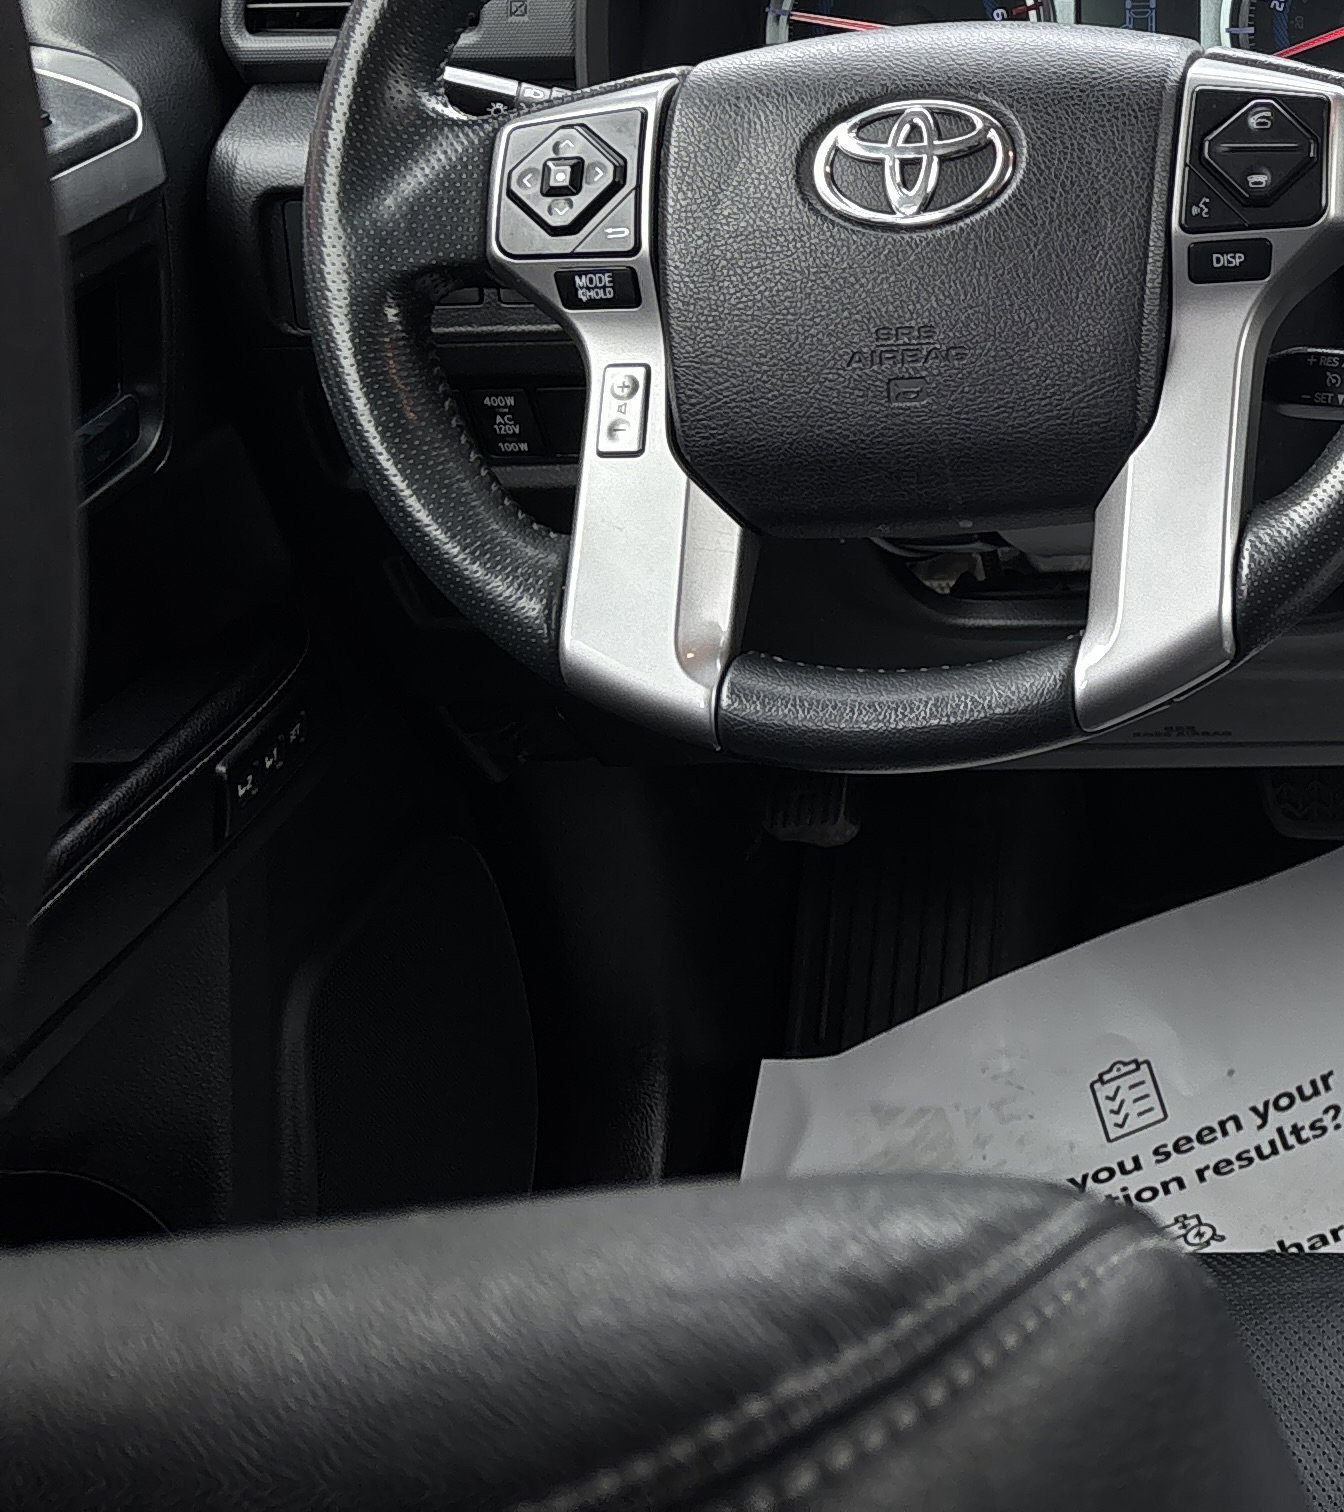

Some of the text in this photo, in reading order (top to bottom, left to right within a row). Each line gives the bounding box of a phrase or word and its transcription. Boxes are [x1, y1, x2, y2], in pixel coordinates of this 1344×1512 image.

[1212, 252, 1245, 268] DISP
[575, 272, 614, 288] MODE
[586, 288, 615, 300] HOLD
[875, 325, 938, 341] SRS
[846, 346, 969, 367] AIRBAG
[1319, 356, 1340, 367] RES
[483, 396, 515, 407] 400W
[1313, 392, 1335, 403] SET
[495, 414, 514, 425] AC
[493, 424, 520, 435] 120V
[498, 442, 529, 452] 100W
[1066, 1069, 1337, 1196] you seen your
[1195, 1103, 1344, 1183] results?
